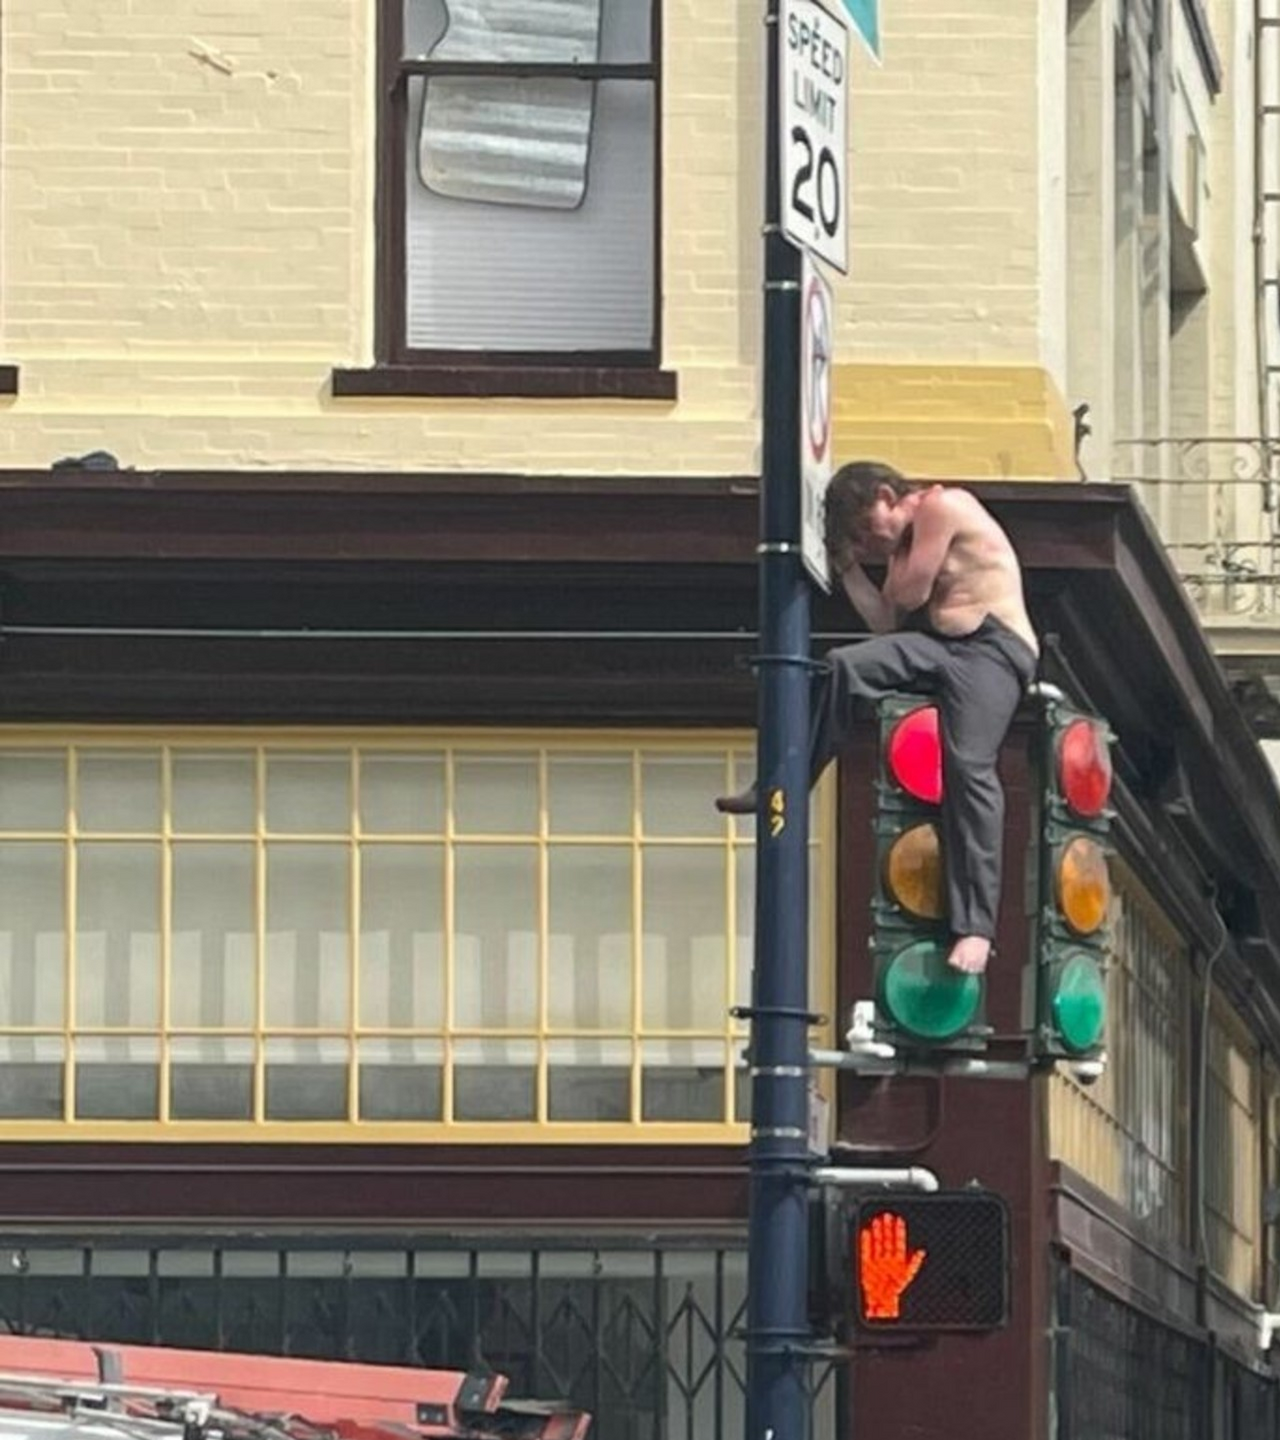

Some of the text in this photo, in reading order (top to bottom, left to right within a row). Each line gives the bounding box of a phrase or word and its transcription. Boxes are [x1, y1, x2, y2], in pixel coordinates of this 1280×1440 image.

[788, 12, 843, 87] SPEED
[792, 71, 837, 134] LIMIT
[790, 125, 841, 239] 20
